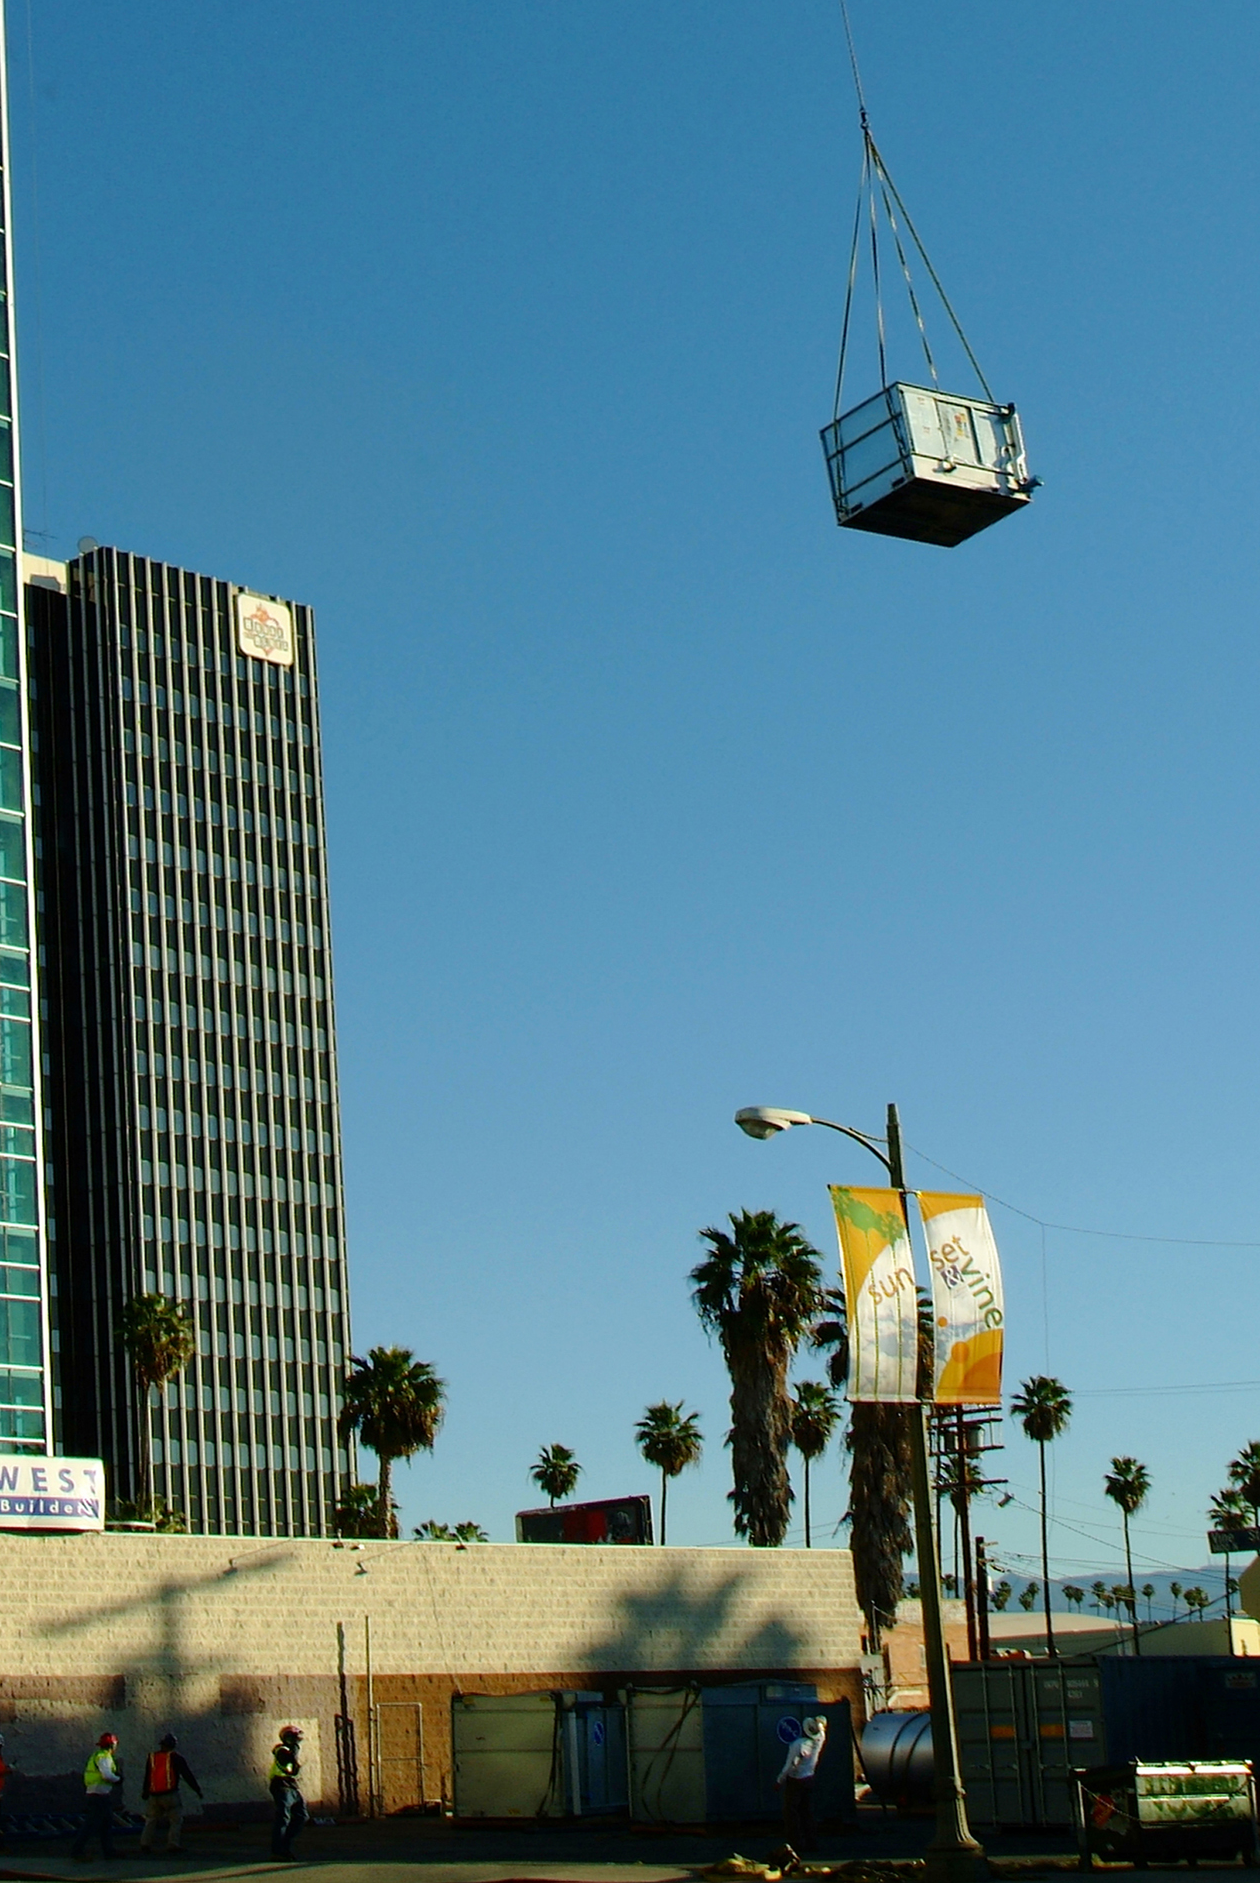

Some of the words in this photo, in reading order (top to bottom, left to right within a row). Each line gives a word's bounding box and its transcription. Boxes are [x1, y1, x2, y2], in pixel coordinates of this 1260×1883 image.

[930, 1234, 970, 1272] set
[867, 1265, 915, 1306] sun
[941, 1265, 965, 1289] &
[961, 1259, 1003, 1329] vine
